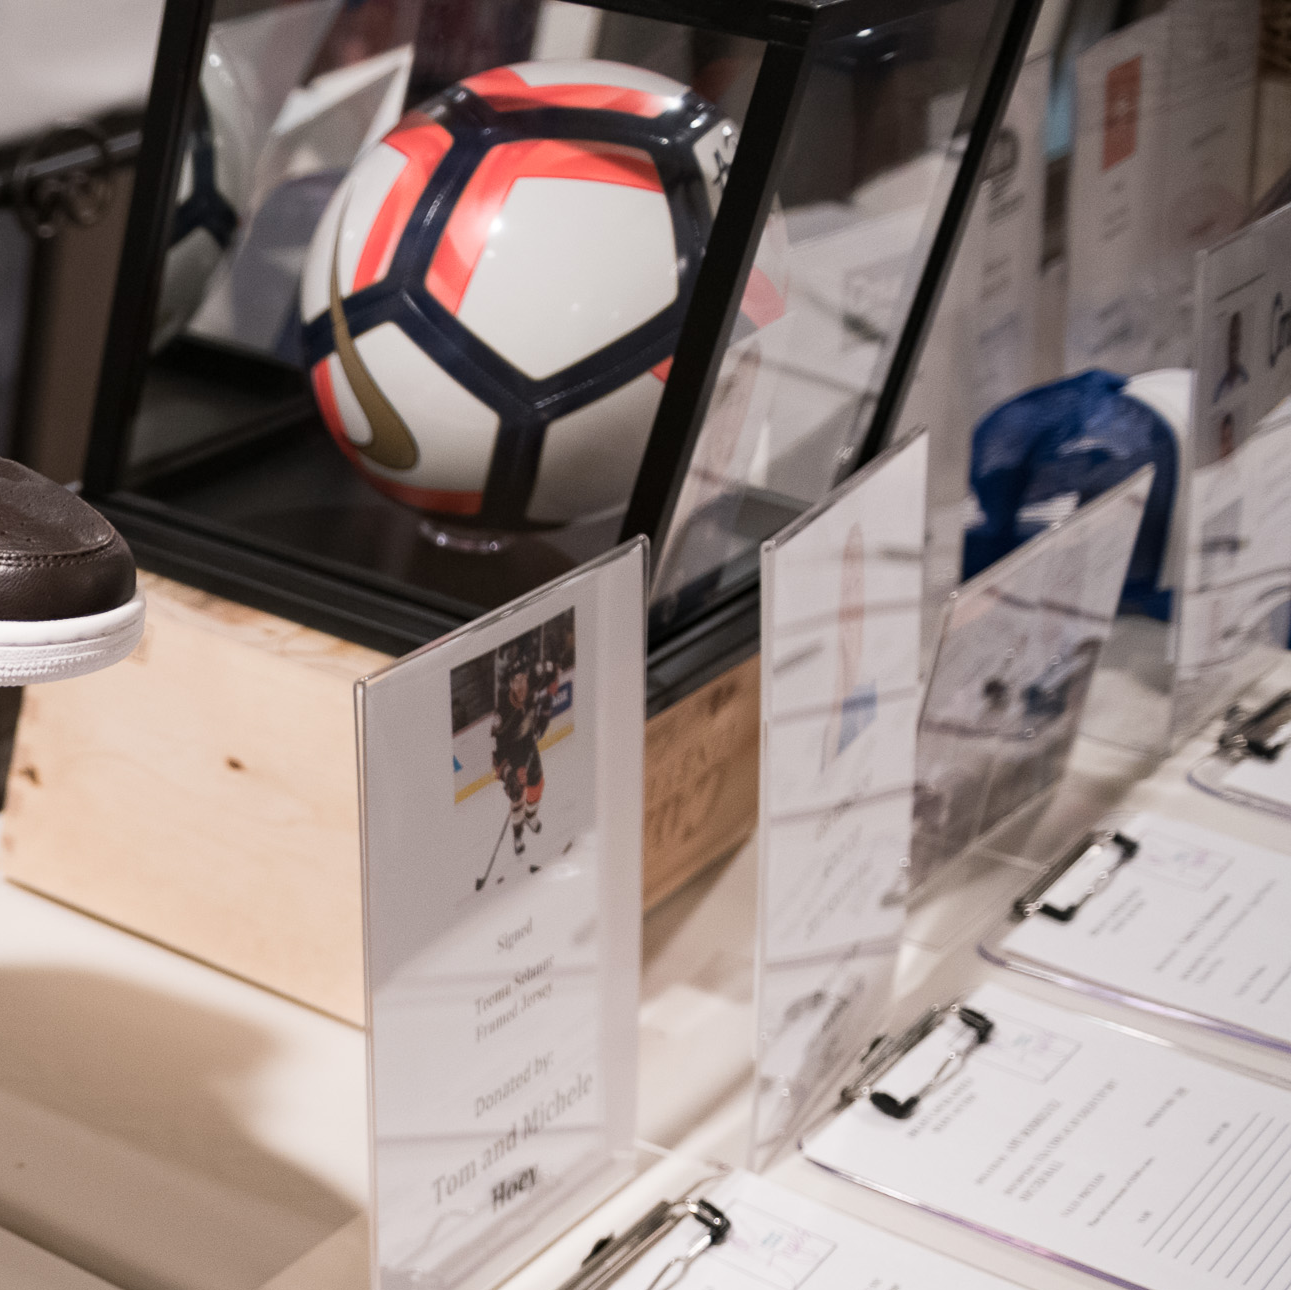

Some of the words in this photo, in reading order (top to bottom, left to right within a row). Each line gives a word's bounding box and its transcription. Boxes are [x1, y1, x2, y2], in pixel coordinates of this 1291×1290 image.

[496, 918, 533, 955] Signed
[474, 1065, 536, 1118] Donated
[530, 1051, 554, 1093] by:
[432, 1157, 478, 1206] Tom
[480, 1126, 517, 1175] and
[521, 1072, 593, 1144] Michele
[491, 1162, 539, 1213] Hoey
